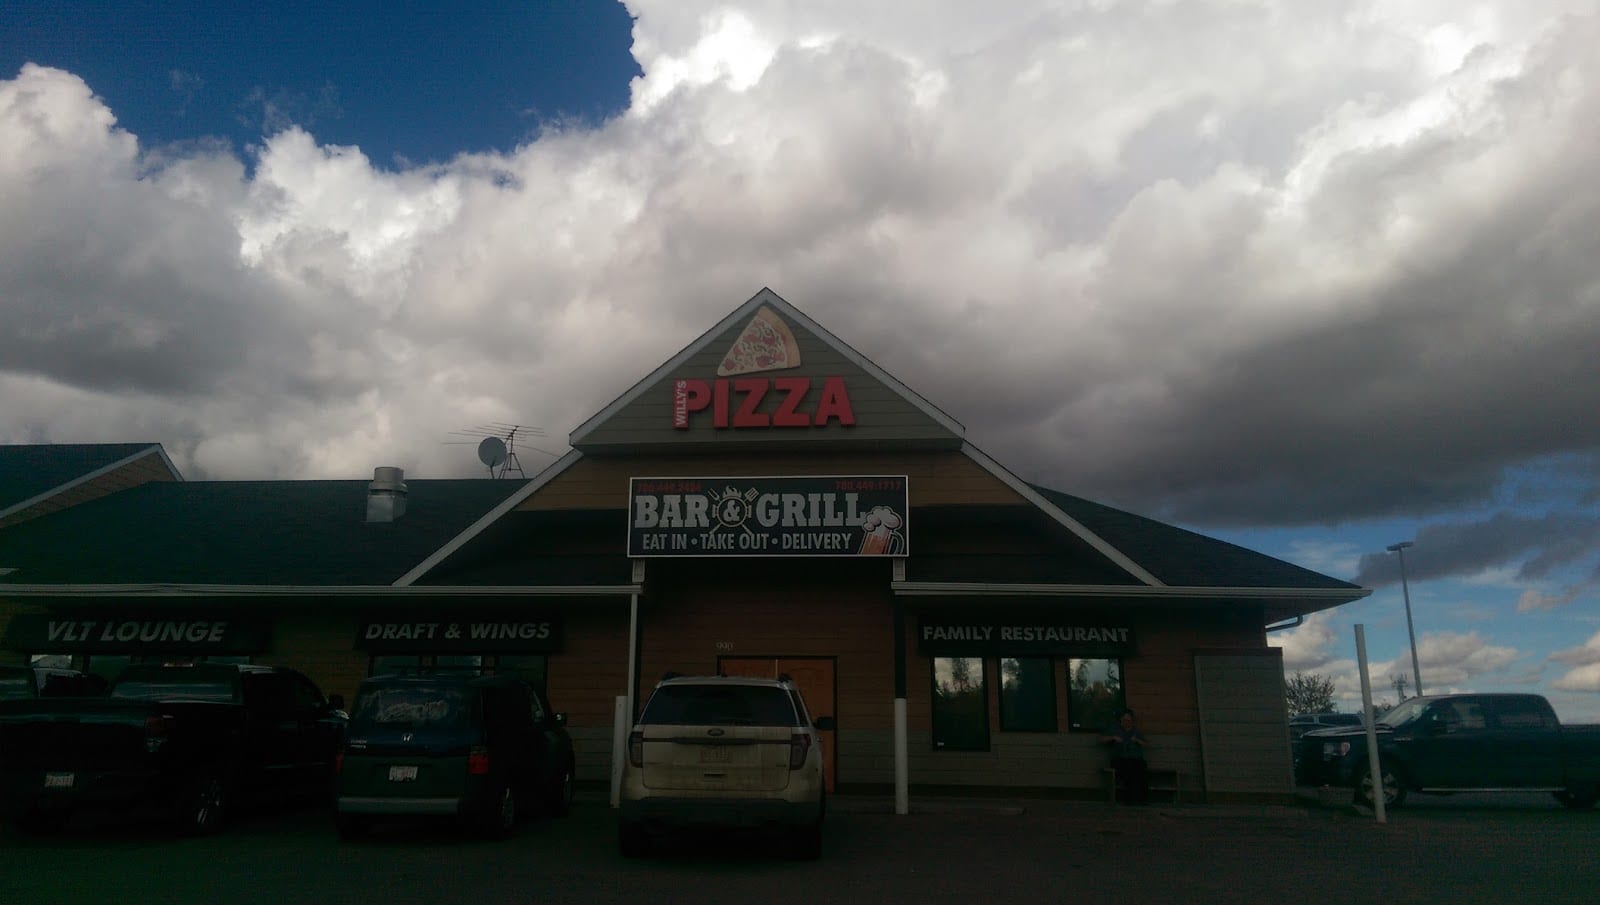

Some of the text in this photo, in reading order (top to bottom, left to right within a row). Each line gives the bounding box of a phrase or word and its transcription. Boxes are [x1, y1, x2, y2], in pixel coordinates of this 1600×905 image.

[673, 376, 857, 429] PIZZA
[676, 380, 687, 426] WILLY'S
[634, 492, 866, 528] BAR & GRILL
[642, 533, 852, 550] EAT IN TAKE OUT DELIVERY
[48, 620, 229, 642] VLT LOUNGE
[365, 622, 551, 640] DRAFT & WINGS
[923, 625, 1129, 642] FAMILY RESTAURANT
